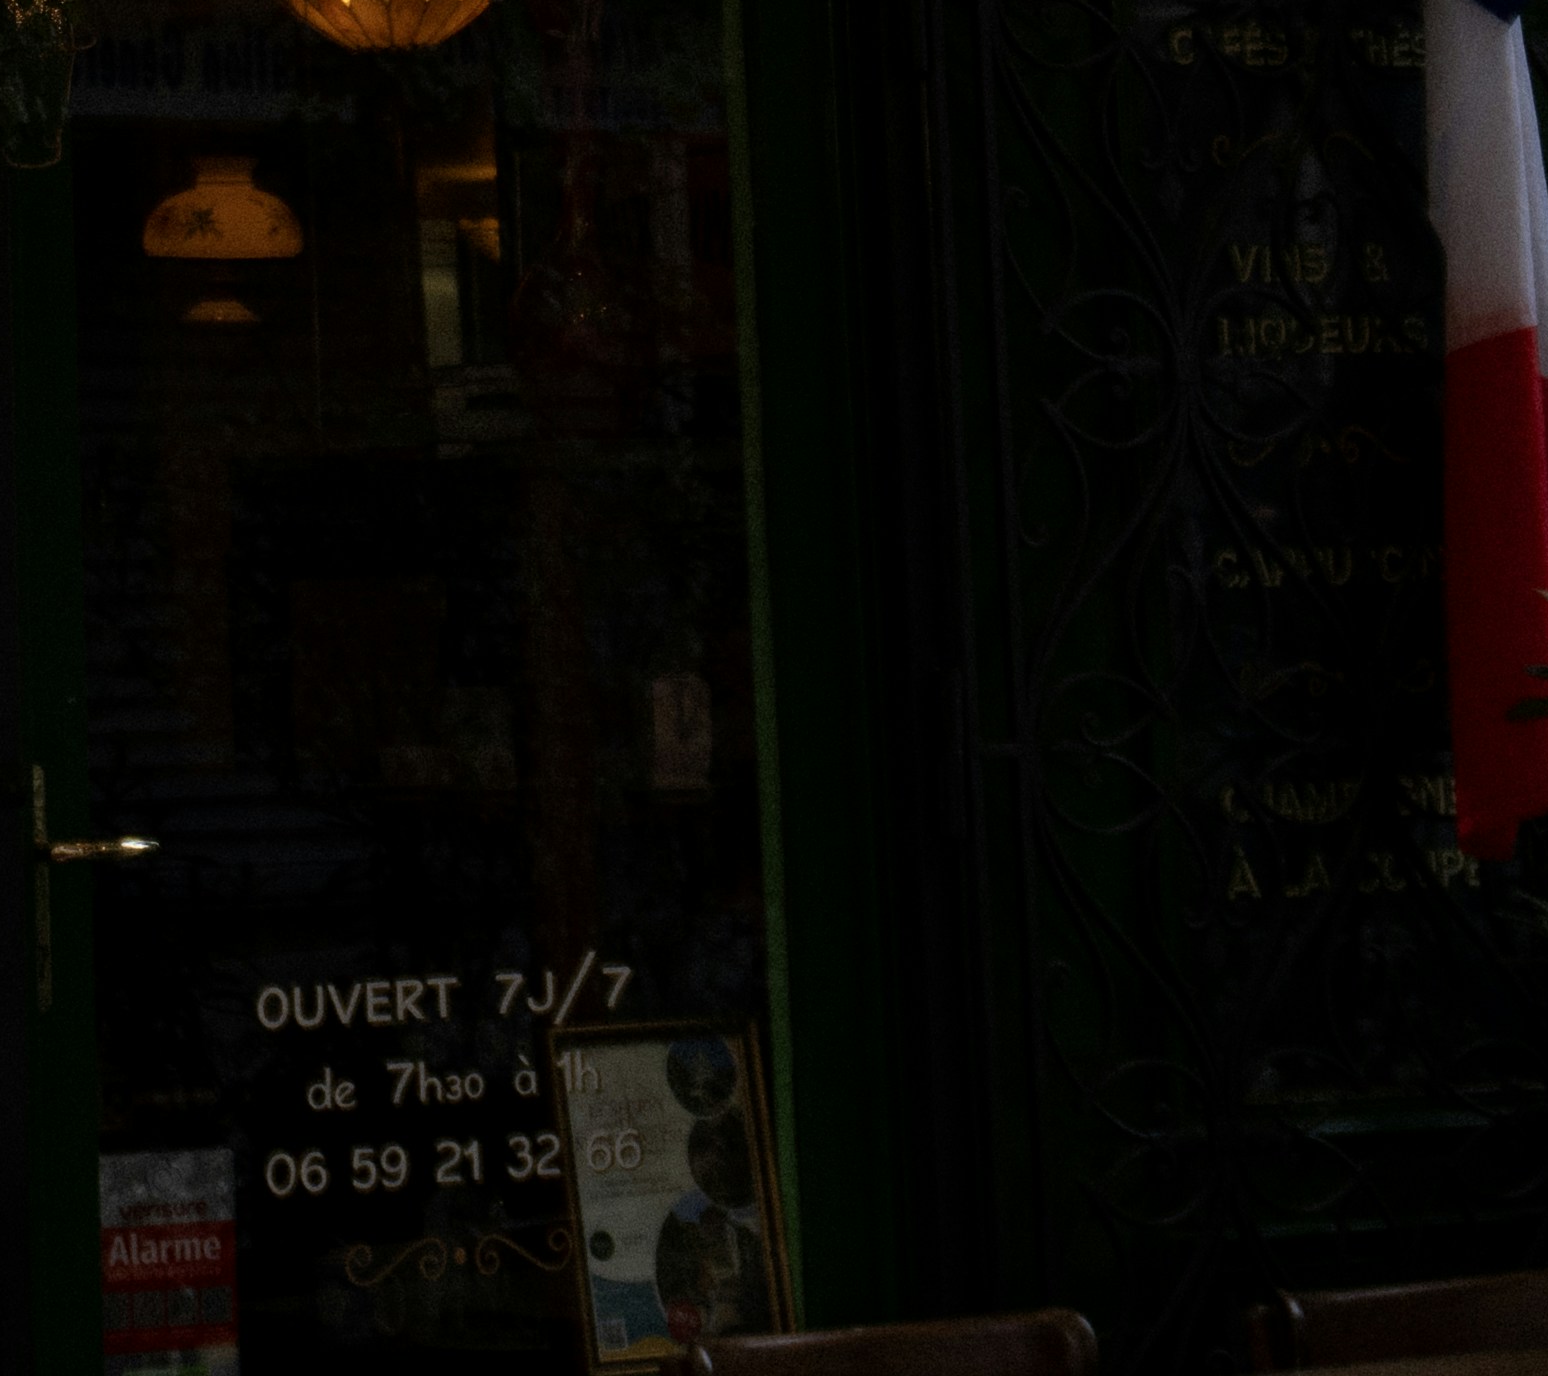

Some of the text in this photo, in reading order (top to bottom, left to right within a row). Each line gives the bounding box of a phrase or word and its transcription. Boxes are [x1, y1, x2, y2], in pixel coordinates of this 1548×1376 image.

[256, 950, 632, 1031] OUVERT 7J/7
[306, 1067, 359, 1111] de
[387, 1061, 486, 1106] 7h30
[512, 1054, 540, 1097] à
[265, 1149, 330, 1199] 06
[351, 1144, 410, 1190] 59
[434, 1140, 484, 1183] 21
[506, 1133, 562, 1178] 32
[585, 1129, 644, 1172] 66
[120, 1200, 208, 1222] verisure
[109, 1231, 222, 1267] Alarme
